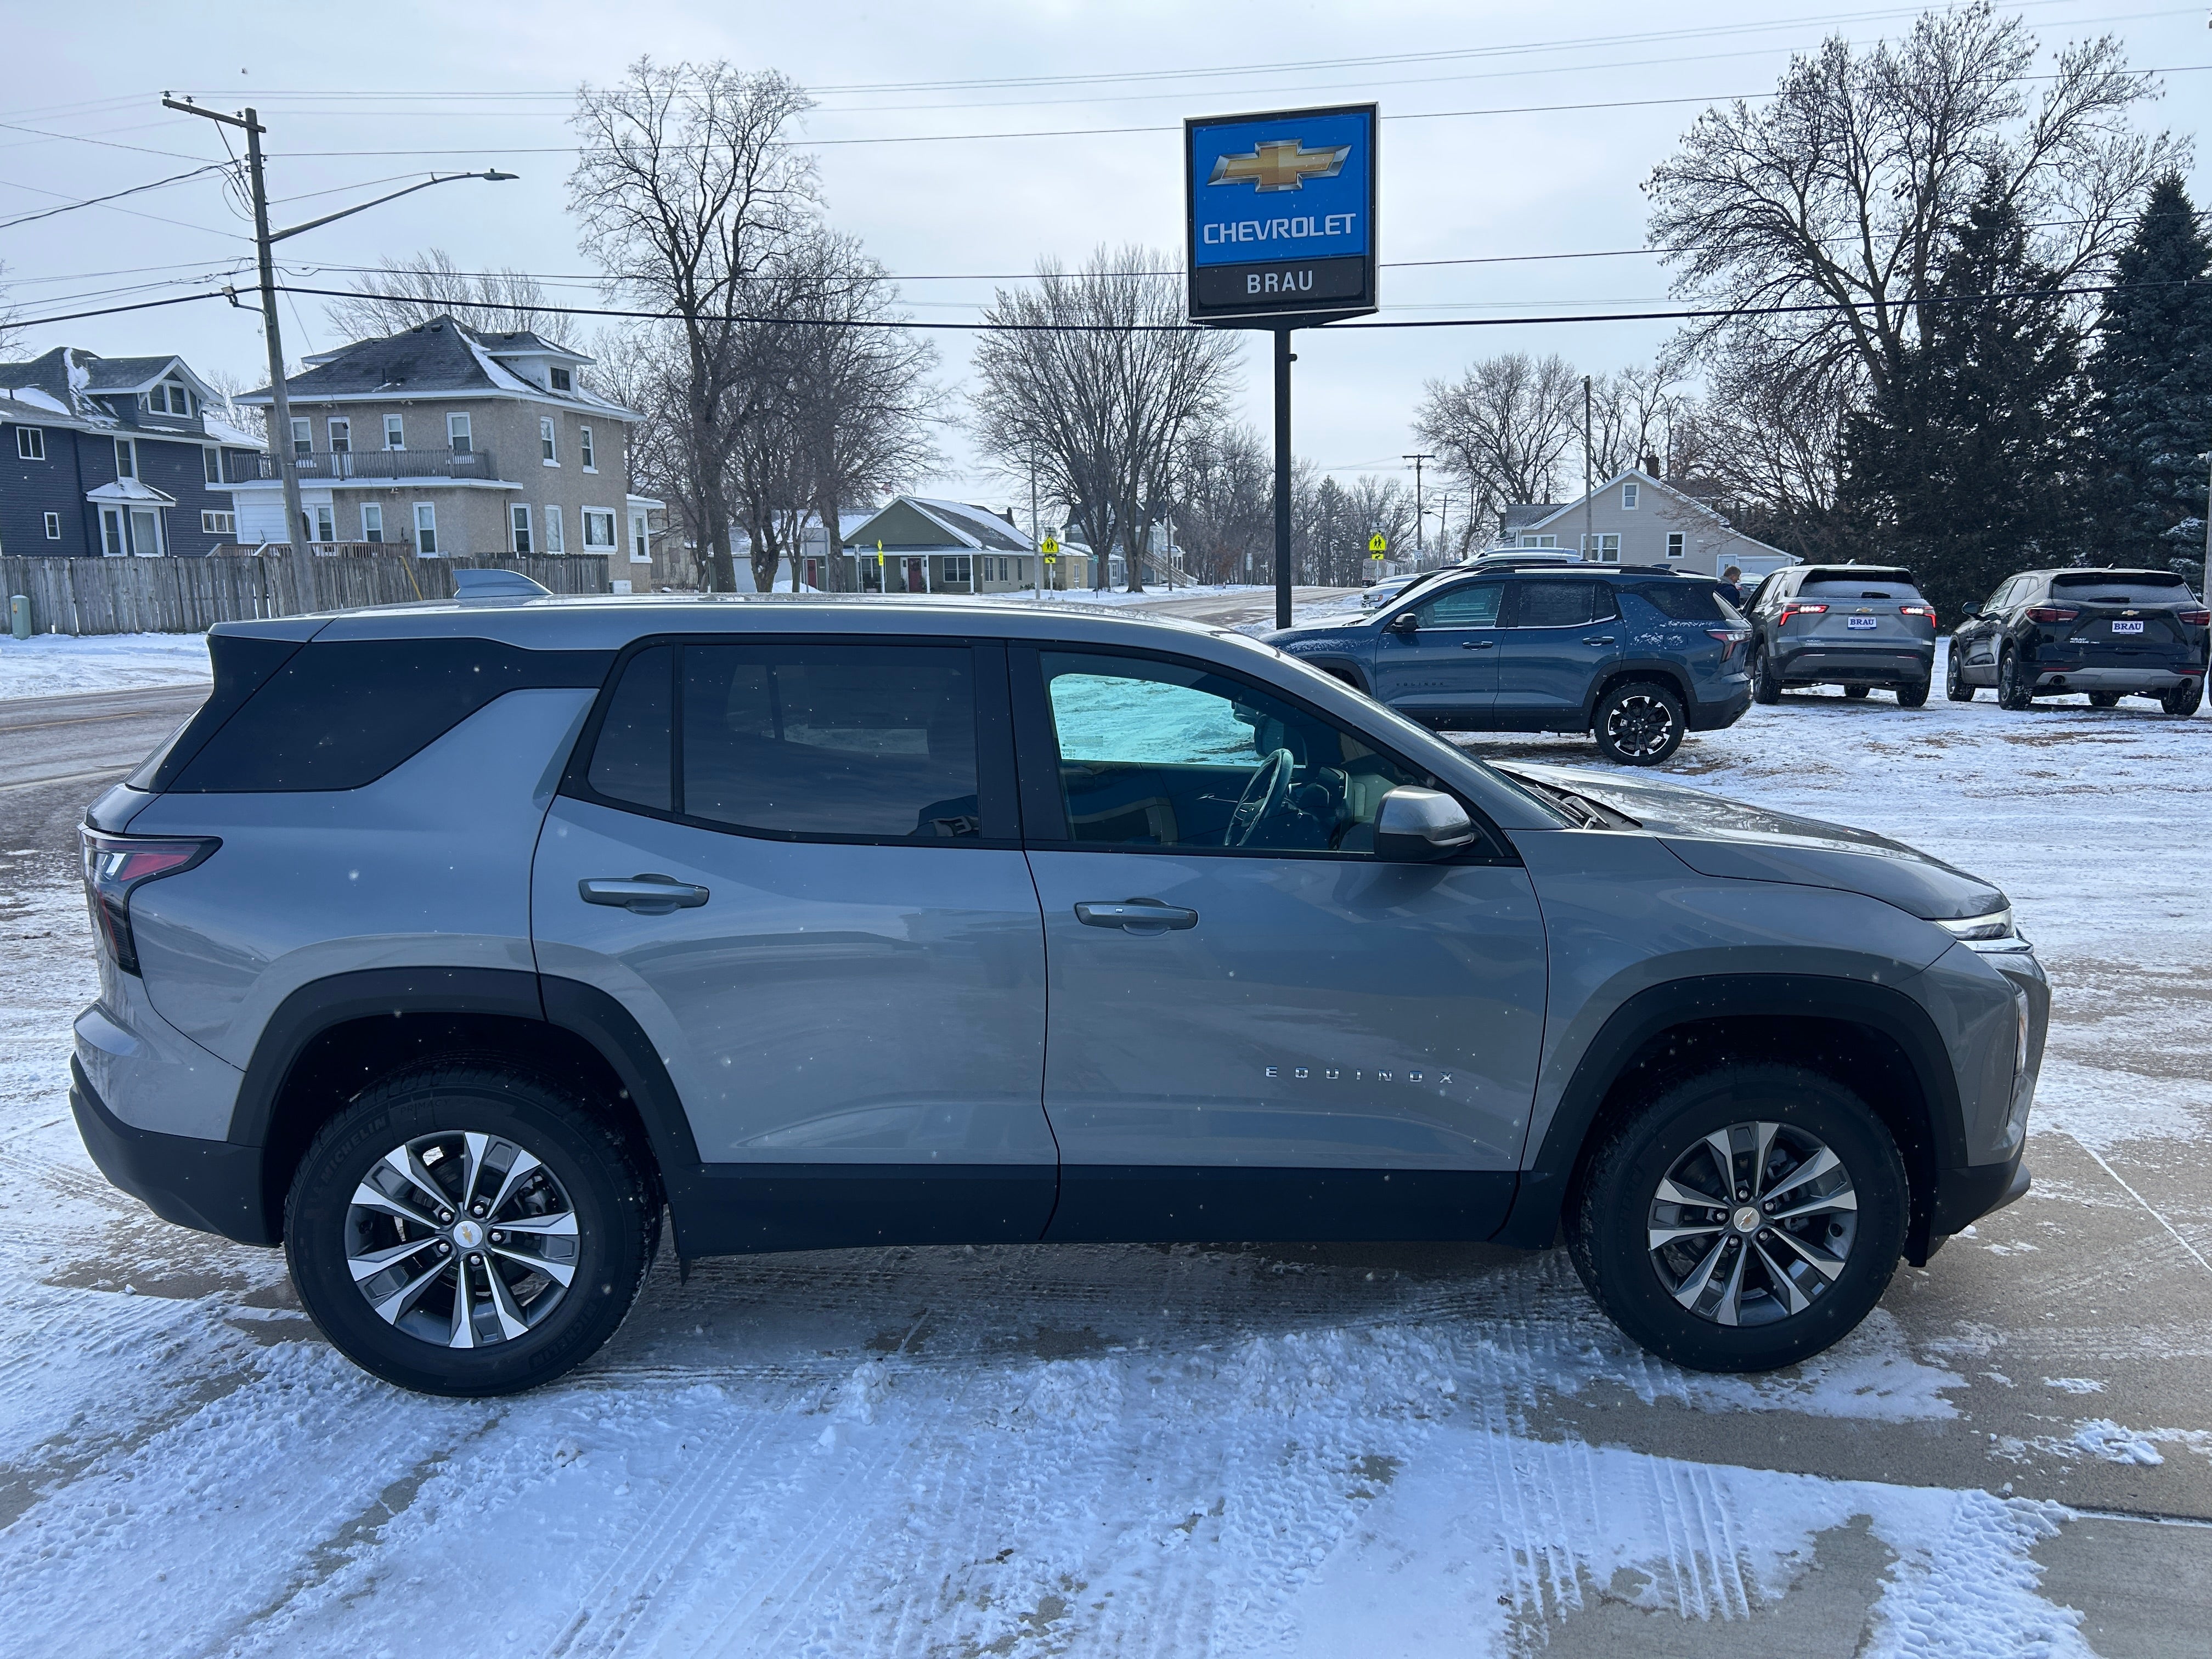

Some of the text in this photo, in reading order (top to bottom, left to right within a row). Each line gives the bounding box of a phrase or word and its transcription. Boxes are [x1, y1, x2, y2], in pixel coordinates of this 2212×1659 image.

[1203, 213, 1356, 245] CHEVROLET
[1246, 270, 1313, 295] BRAU
[1265, 1065, 1454, 1084] EQUINOX
[400, 1098, 448, 1115] PRIMACY
[320, 1115, 387, 1186] MICHELIN
[532, 1301, 597, 1368] MICHELIN
